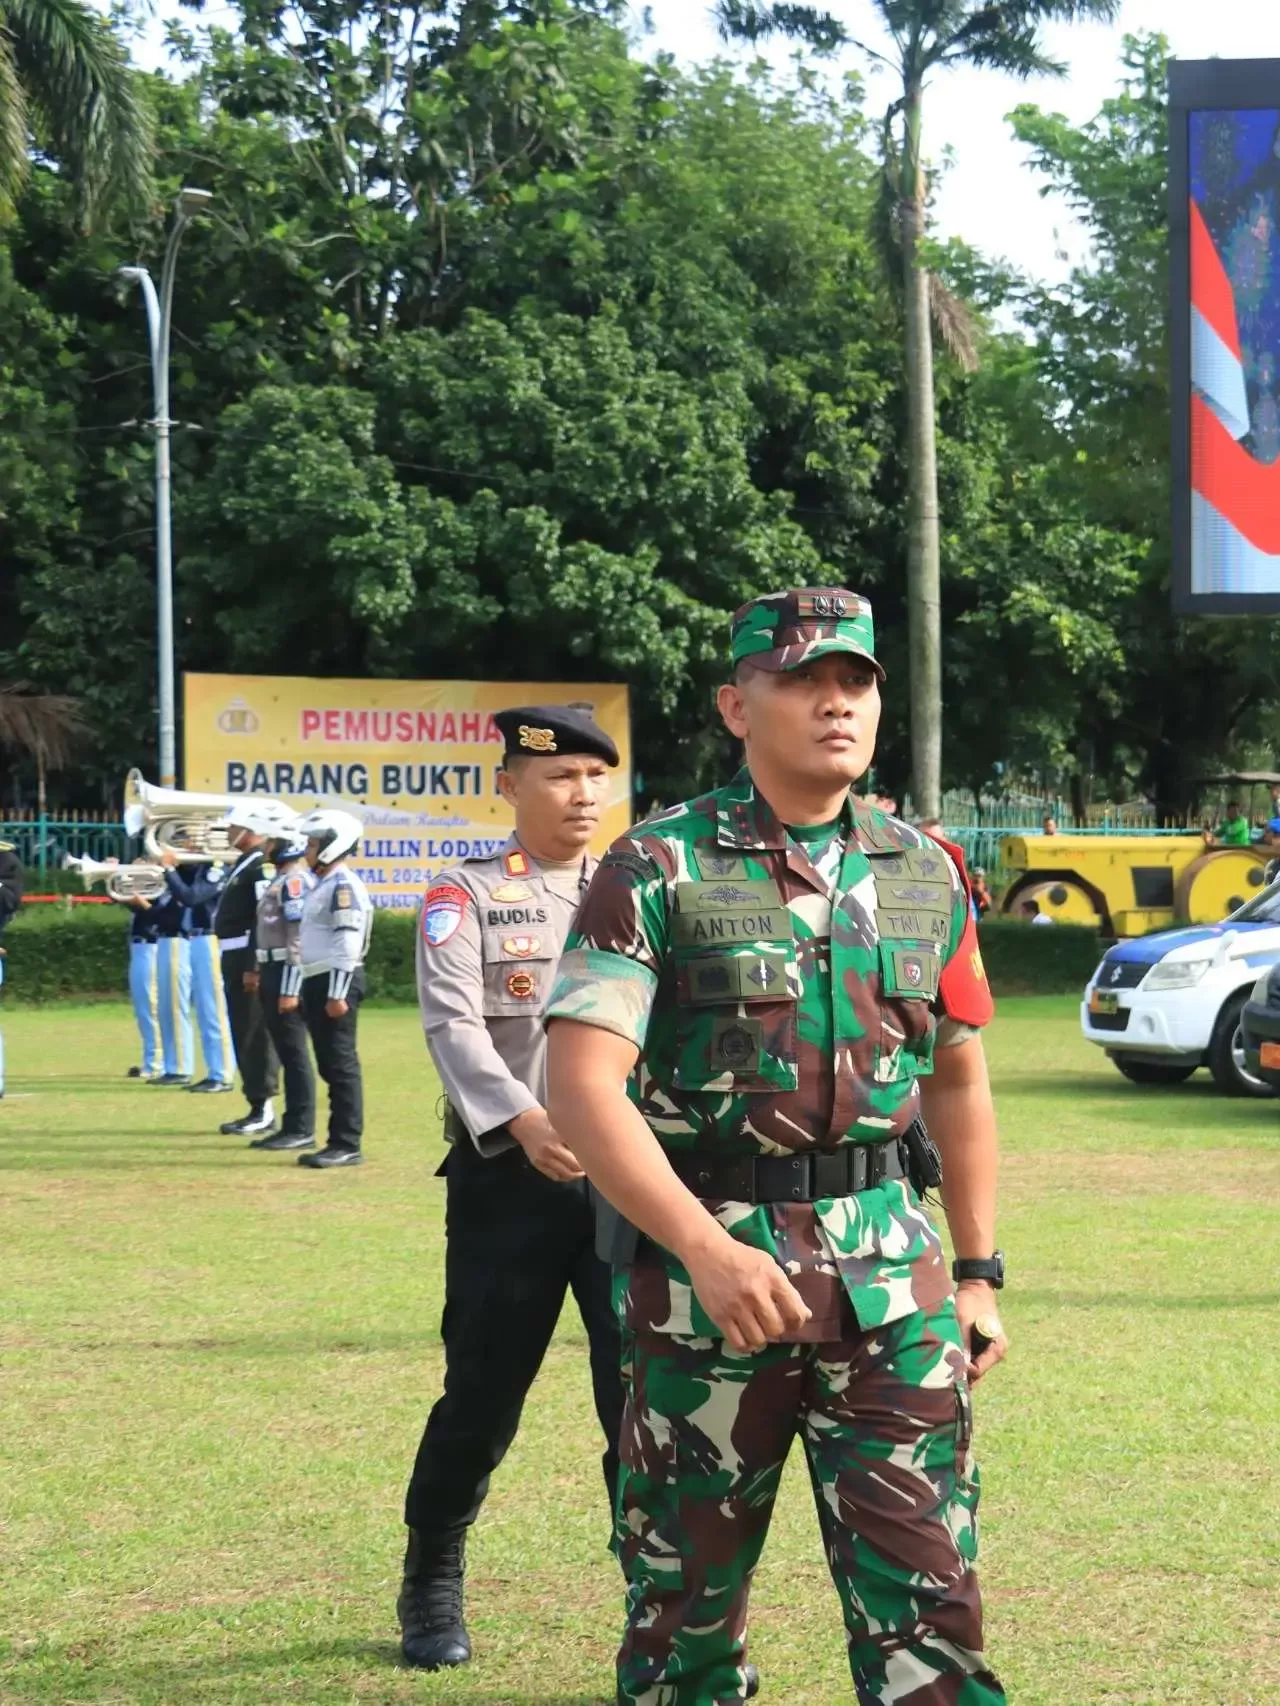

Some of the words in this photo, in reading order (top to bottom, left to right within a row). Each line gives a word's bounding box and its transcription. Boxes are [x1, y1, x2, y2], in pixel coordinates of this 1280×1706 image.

[302, 710, 501, 743] PEMUSNAHA
[226, 761, 368, 795] BARANG
[382, 763, 480, 796] BUKTI
[363, 840, 420, 857] LILIN
[392, 867, 433, 884] 2024
[487, 908, 548, 926] BUDI.S
[887, 915, 921, 934] TNI
[693, 915, 774, 939] ANTON
